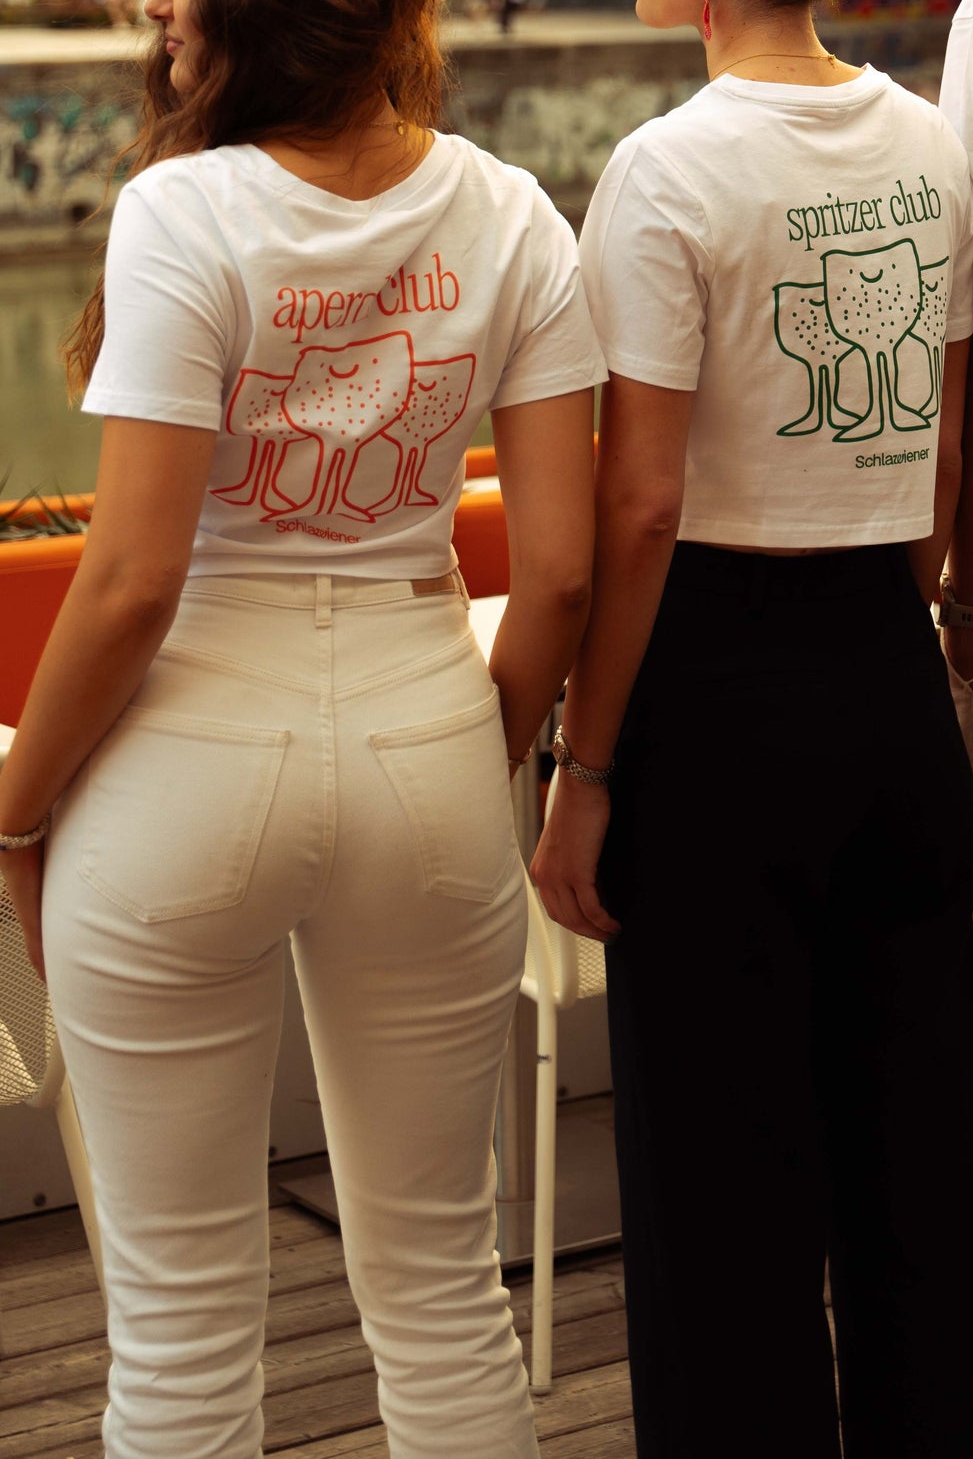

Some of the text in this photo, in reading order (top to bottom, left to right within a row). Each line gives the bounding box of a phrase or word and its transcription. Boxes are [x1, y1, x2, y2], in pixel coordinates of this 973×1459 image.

[786, 175, 941, 251] spritzer club
[376, 252, 460, 316] club
[855, 448, 930, 468] Schlawiener
